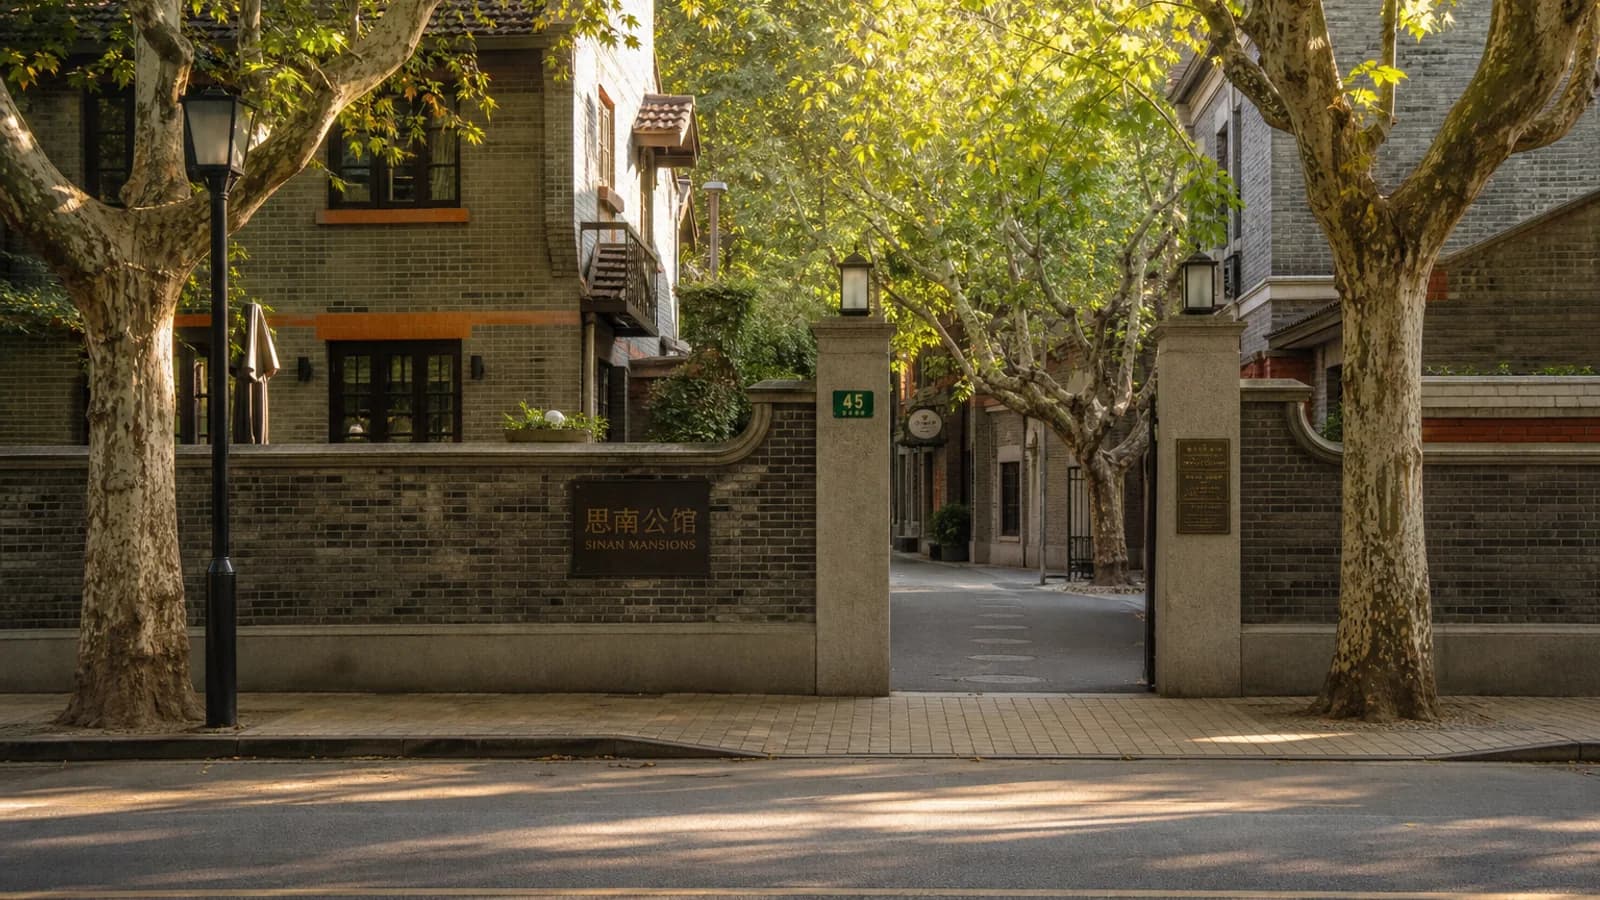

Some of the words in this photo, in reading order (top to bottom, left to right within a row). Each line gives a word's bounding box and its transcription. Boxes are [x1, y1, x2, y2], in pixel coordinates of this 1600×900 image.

[843, 393, 863, 409] 45
[585, 507, 697, 534] 思南公馆
[585, 540, 625, 551] SINAN
[628, 540, 697, 551] MANSIONS
